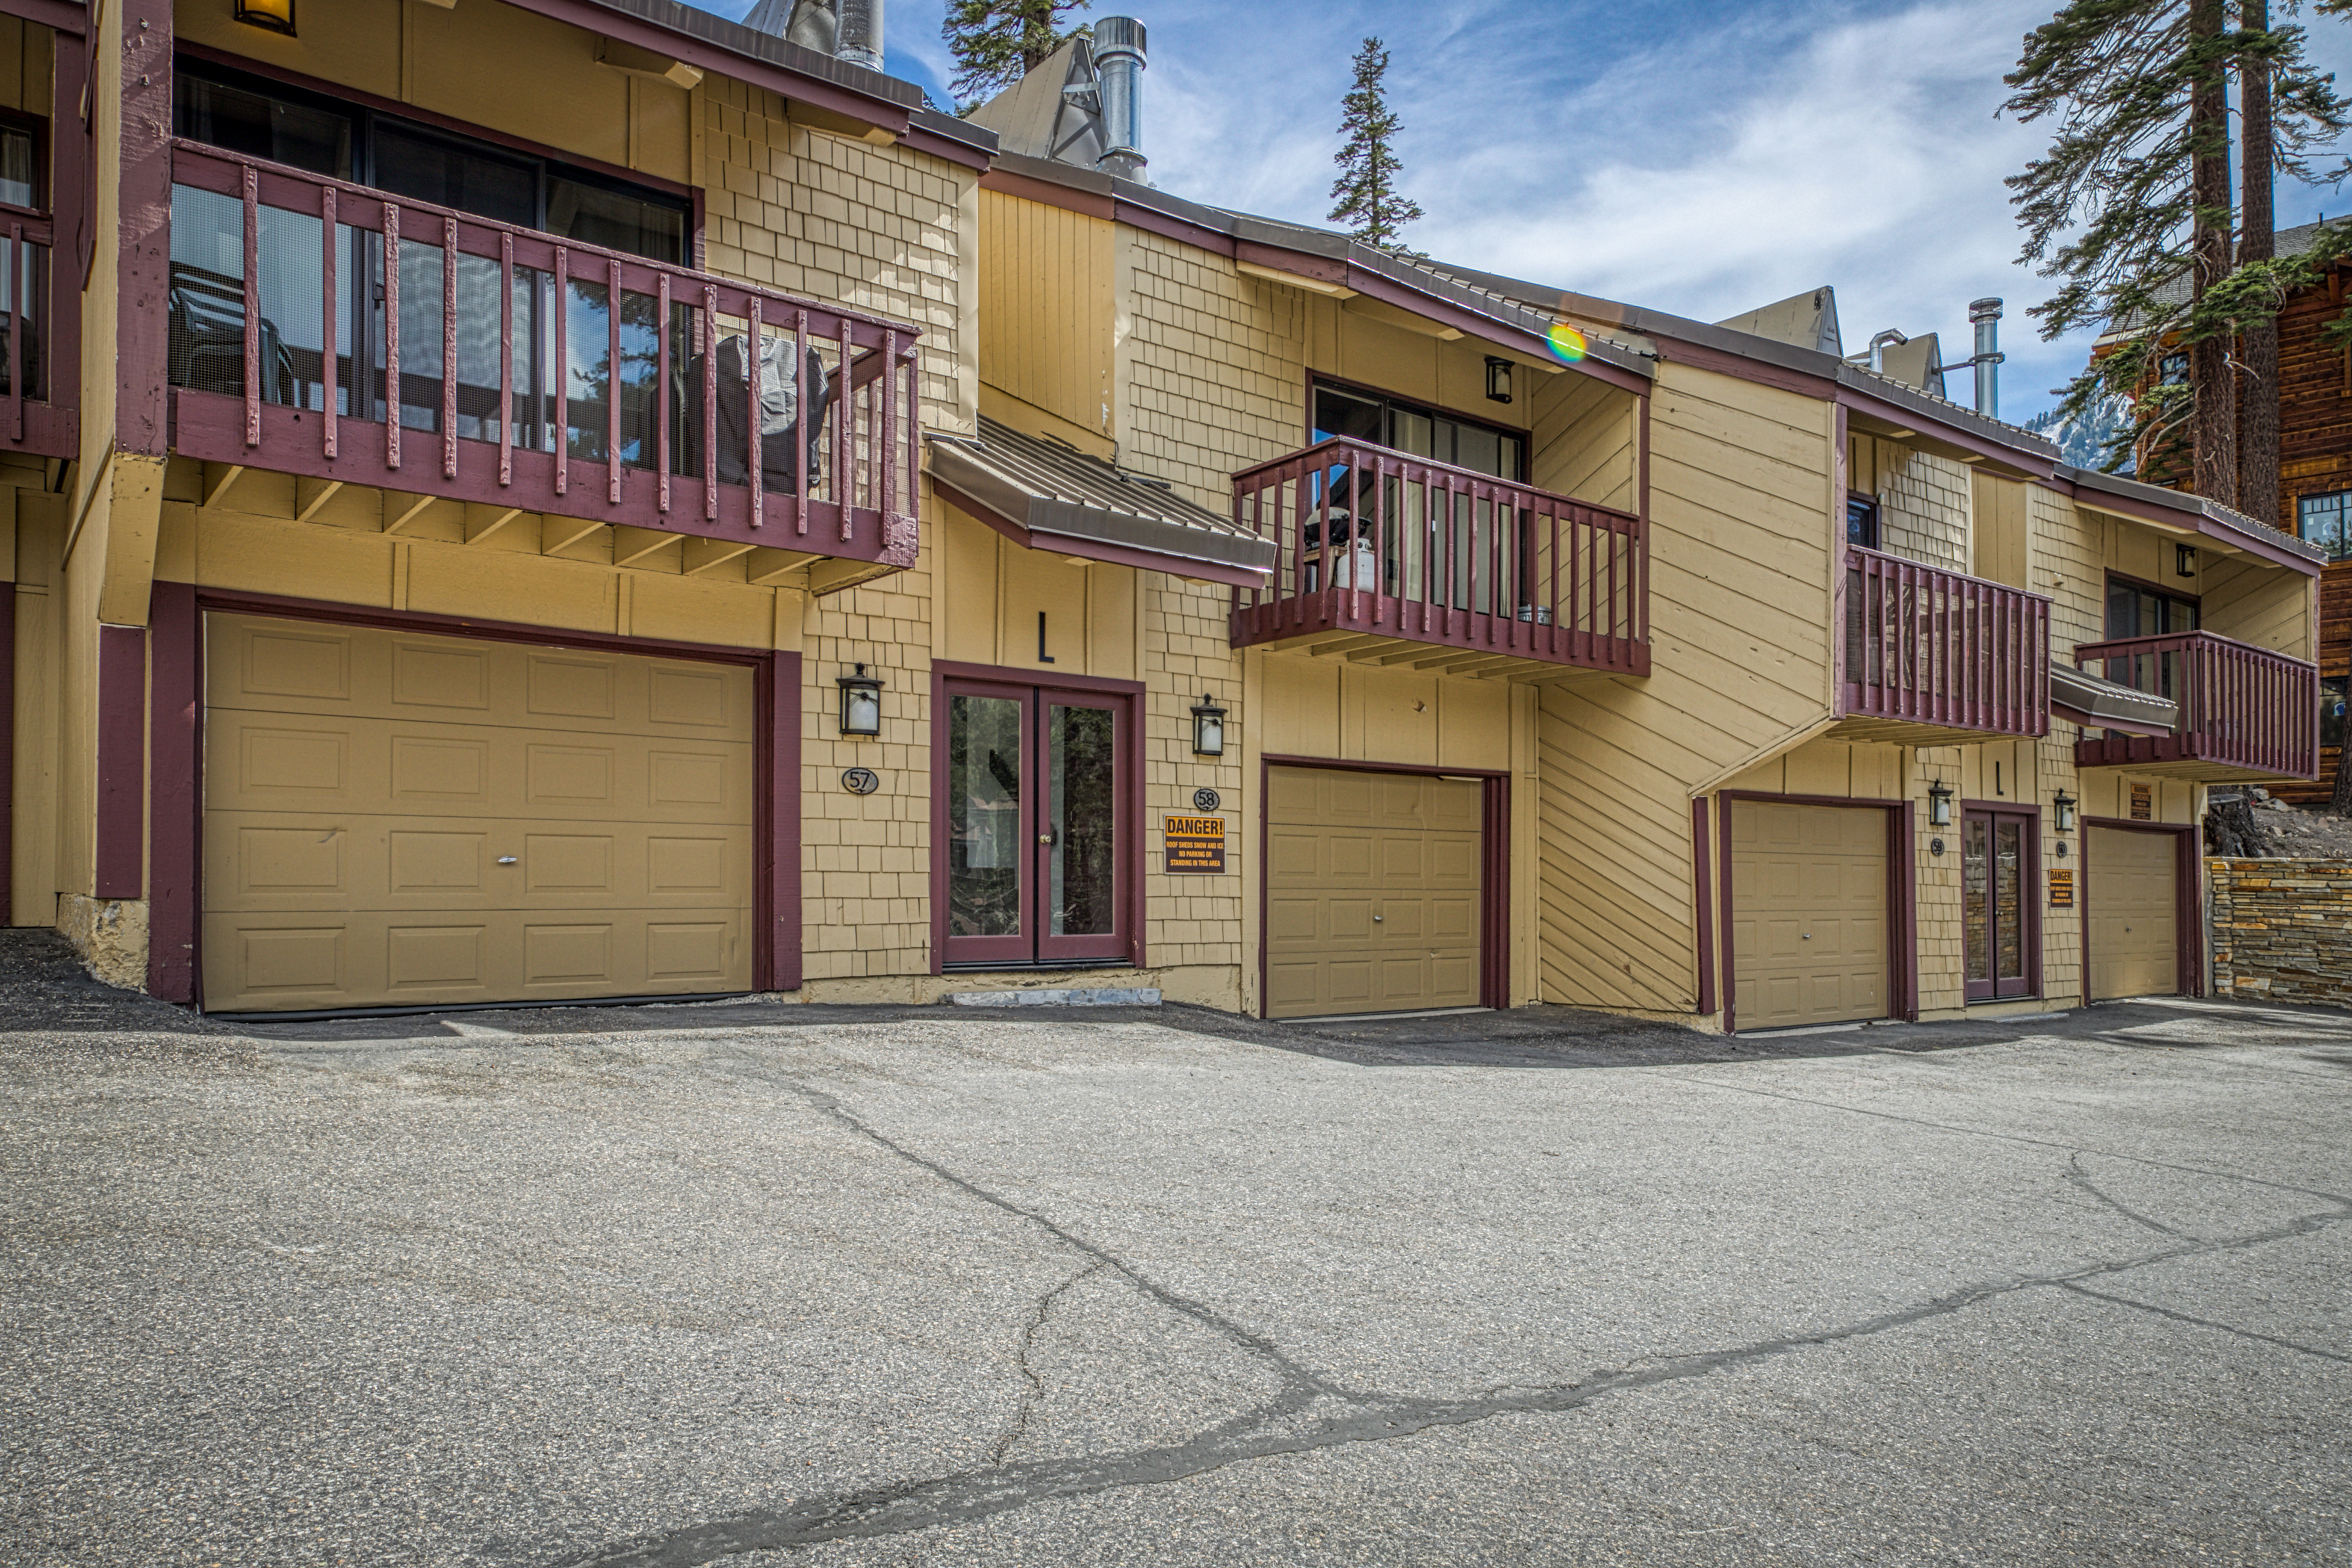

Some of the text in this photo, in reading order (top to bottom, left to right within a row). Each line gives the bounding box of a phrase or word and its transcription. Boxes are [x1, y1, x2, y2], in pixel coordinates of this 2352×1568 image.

[1038, 611, 1055, 663] L
[850, 772, 870, 789] 57
[1996, 761, 2004, 796] L
[1199, 792, 1215, 806] 58
[1167, 819, 1223, 835] DANGER!
[1934, 841, 1942, 852] 59
[2058, 844, 2065, 854] 60
[2050, 870, 2072, 881] DANGER!
